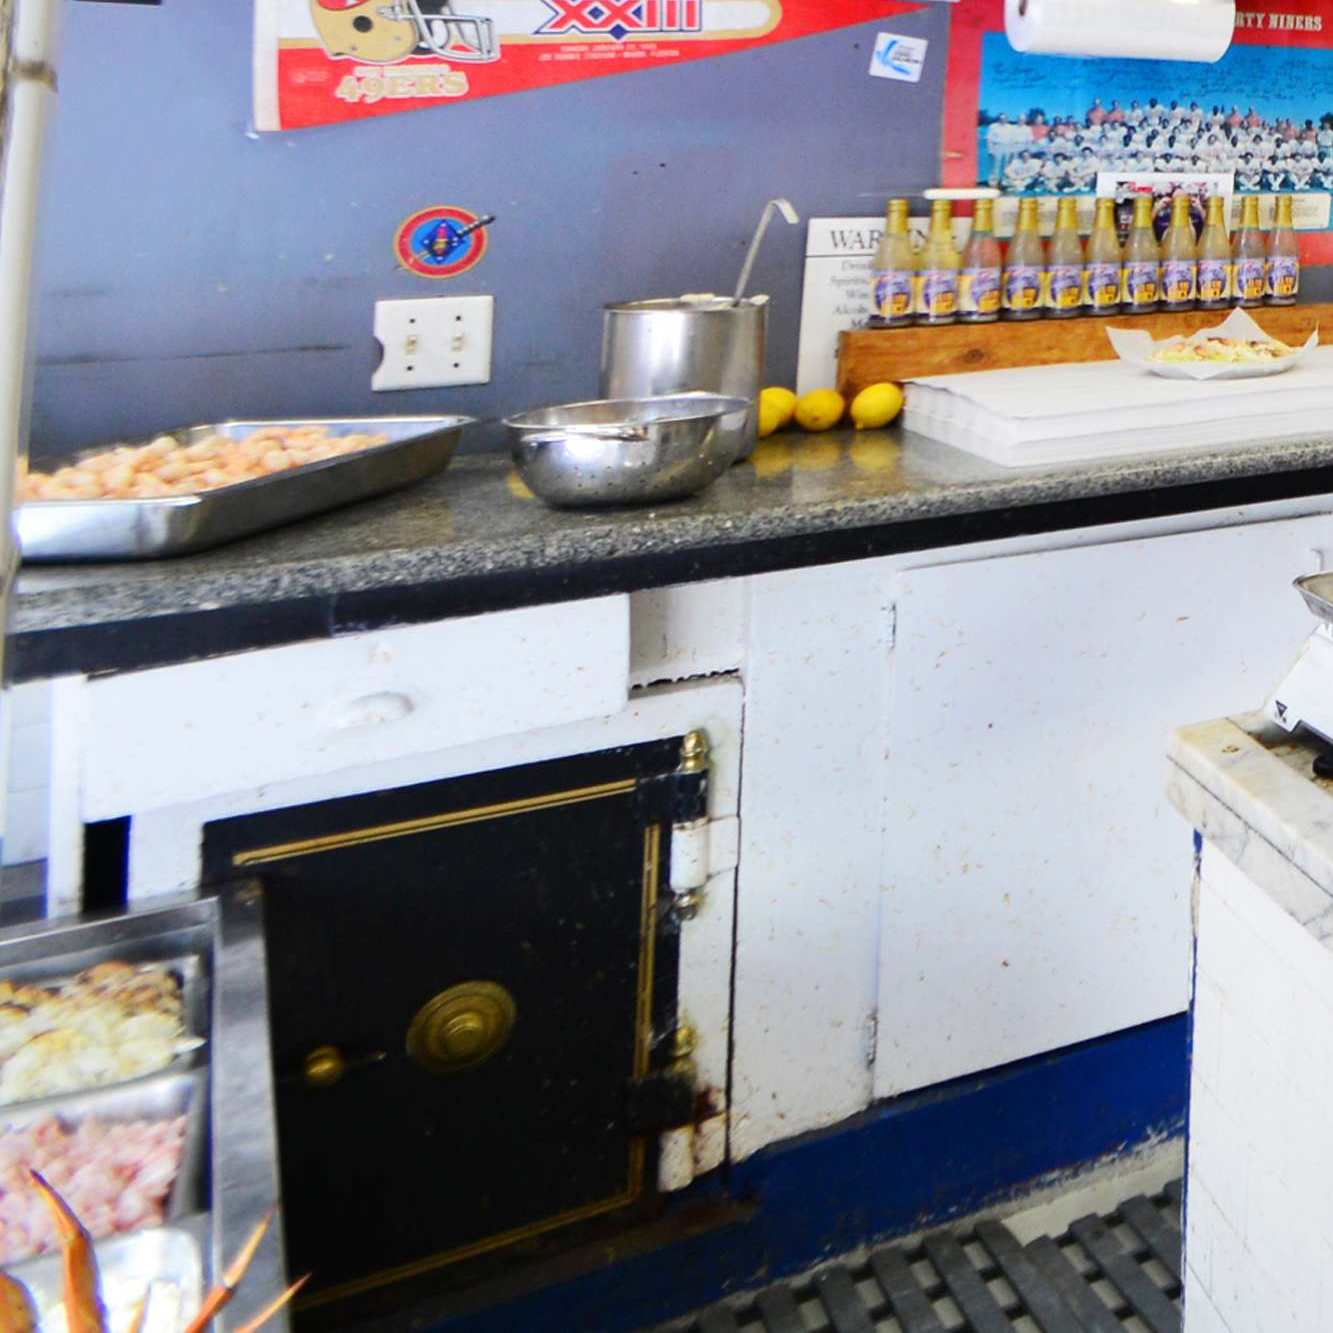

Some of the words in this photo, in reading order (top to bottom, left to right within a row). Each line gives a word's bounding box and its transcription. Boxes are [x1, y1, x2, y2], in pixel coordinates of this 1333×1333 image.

[1235, 10, 1266, 29] RTY
[1267, 12, 1323, 33] NINERS
[335, 70, 470, 104] 49ERS
